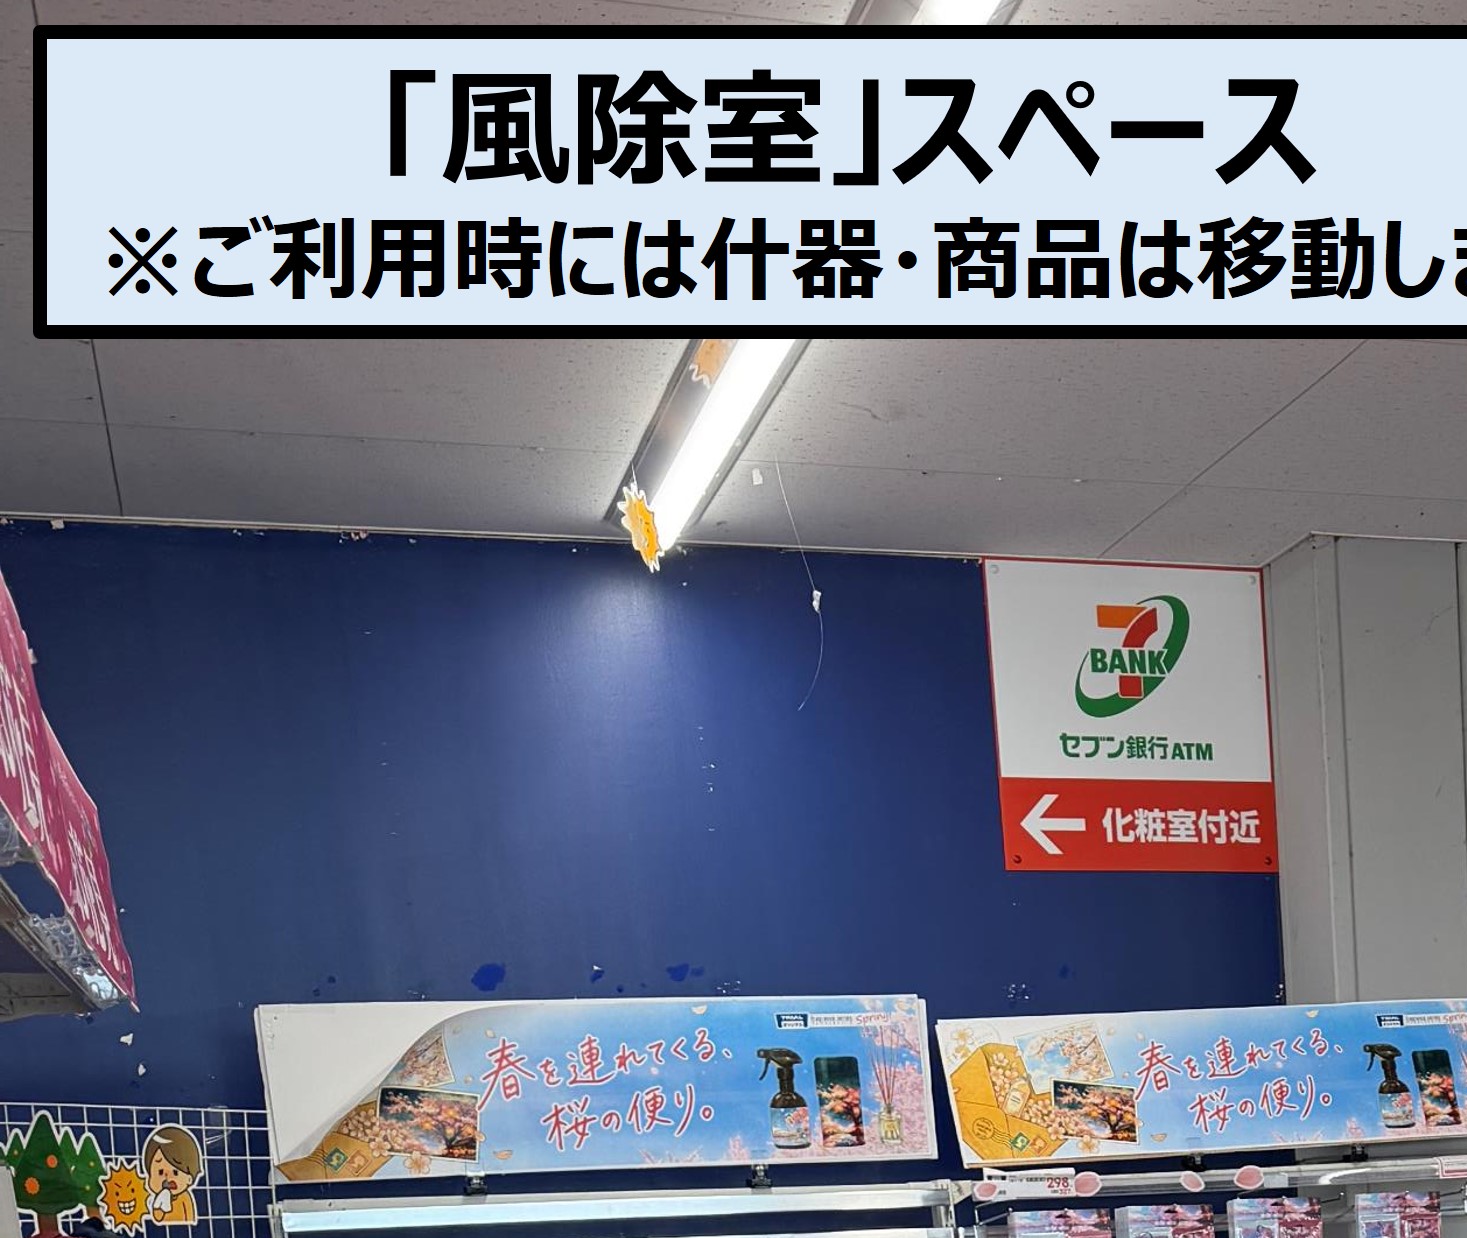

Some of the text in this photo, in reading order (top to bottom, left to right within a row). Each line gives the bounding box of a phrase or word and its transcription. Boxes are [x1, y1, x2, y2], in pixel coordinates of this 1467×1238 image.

[1089, 648, 1167, 676] BANK
[1101, 807, 1262, 845] 化粧室付近
[477, 1027, 734, 1112] 春を連れてくる、
[1134, 1026, 1345, 1101] 春を連れてくる、
[539, 1083, 715, 1153] 桜の便り。
[1187, 1074, 1333, 1136] 桜の便り。
